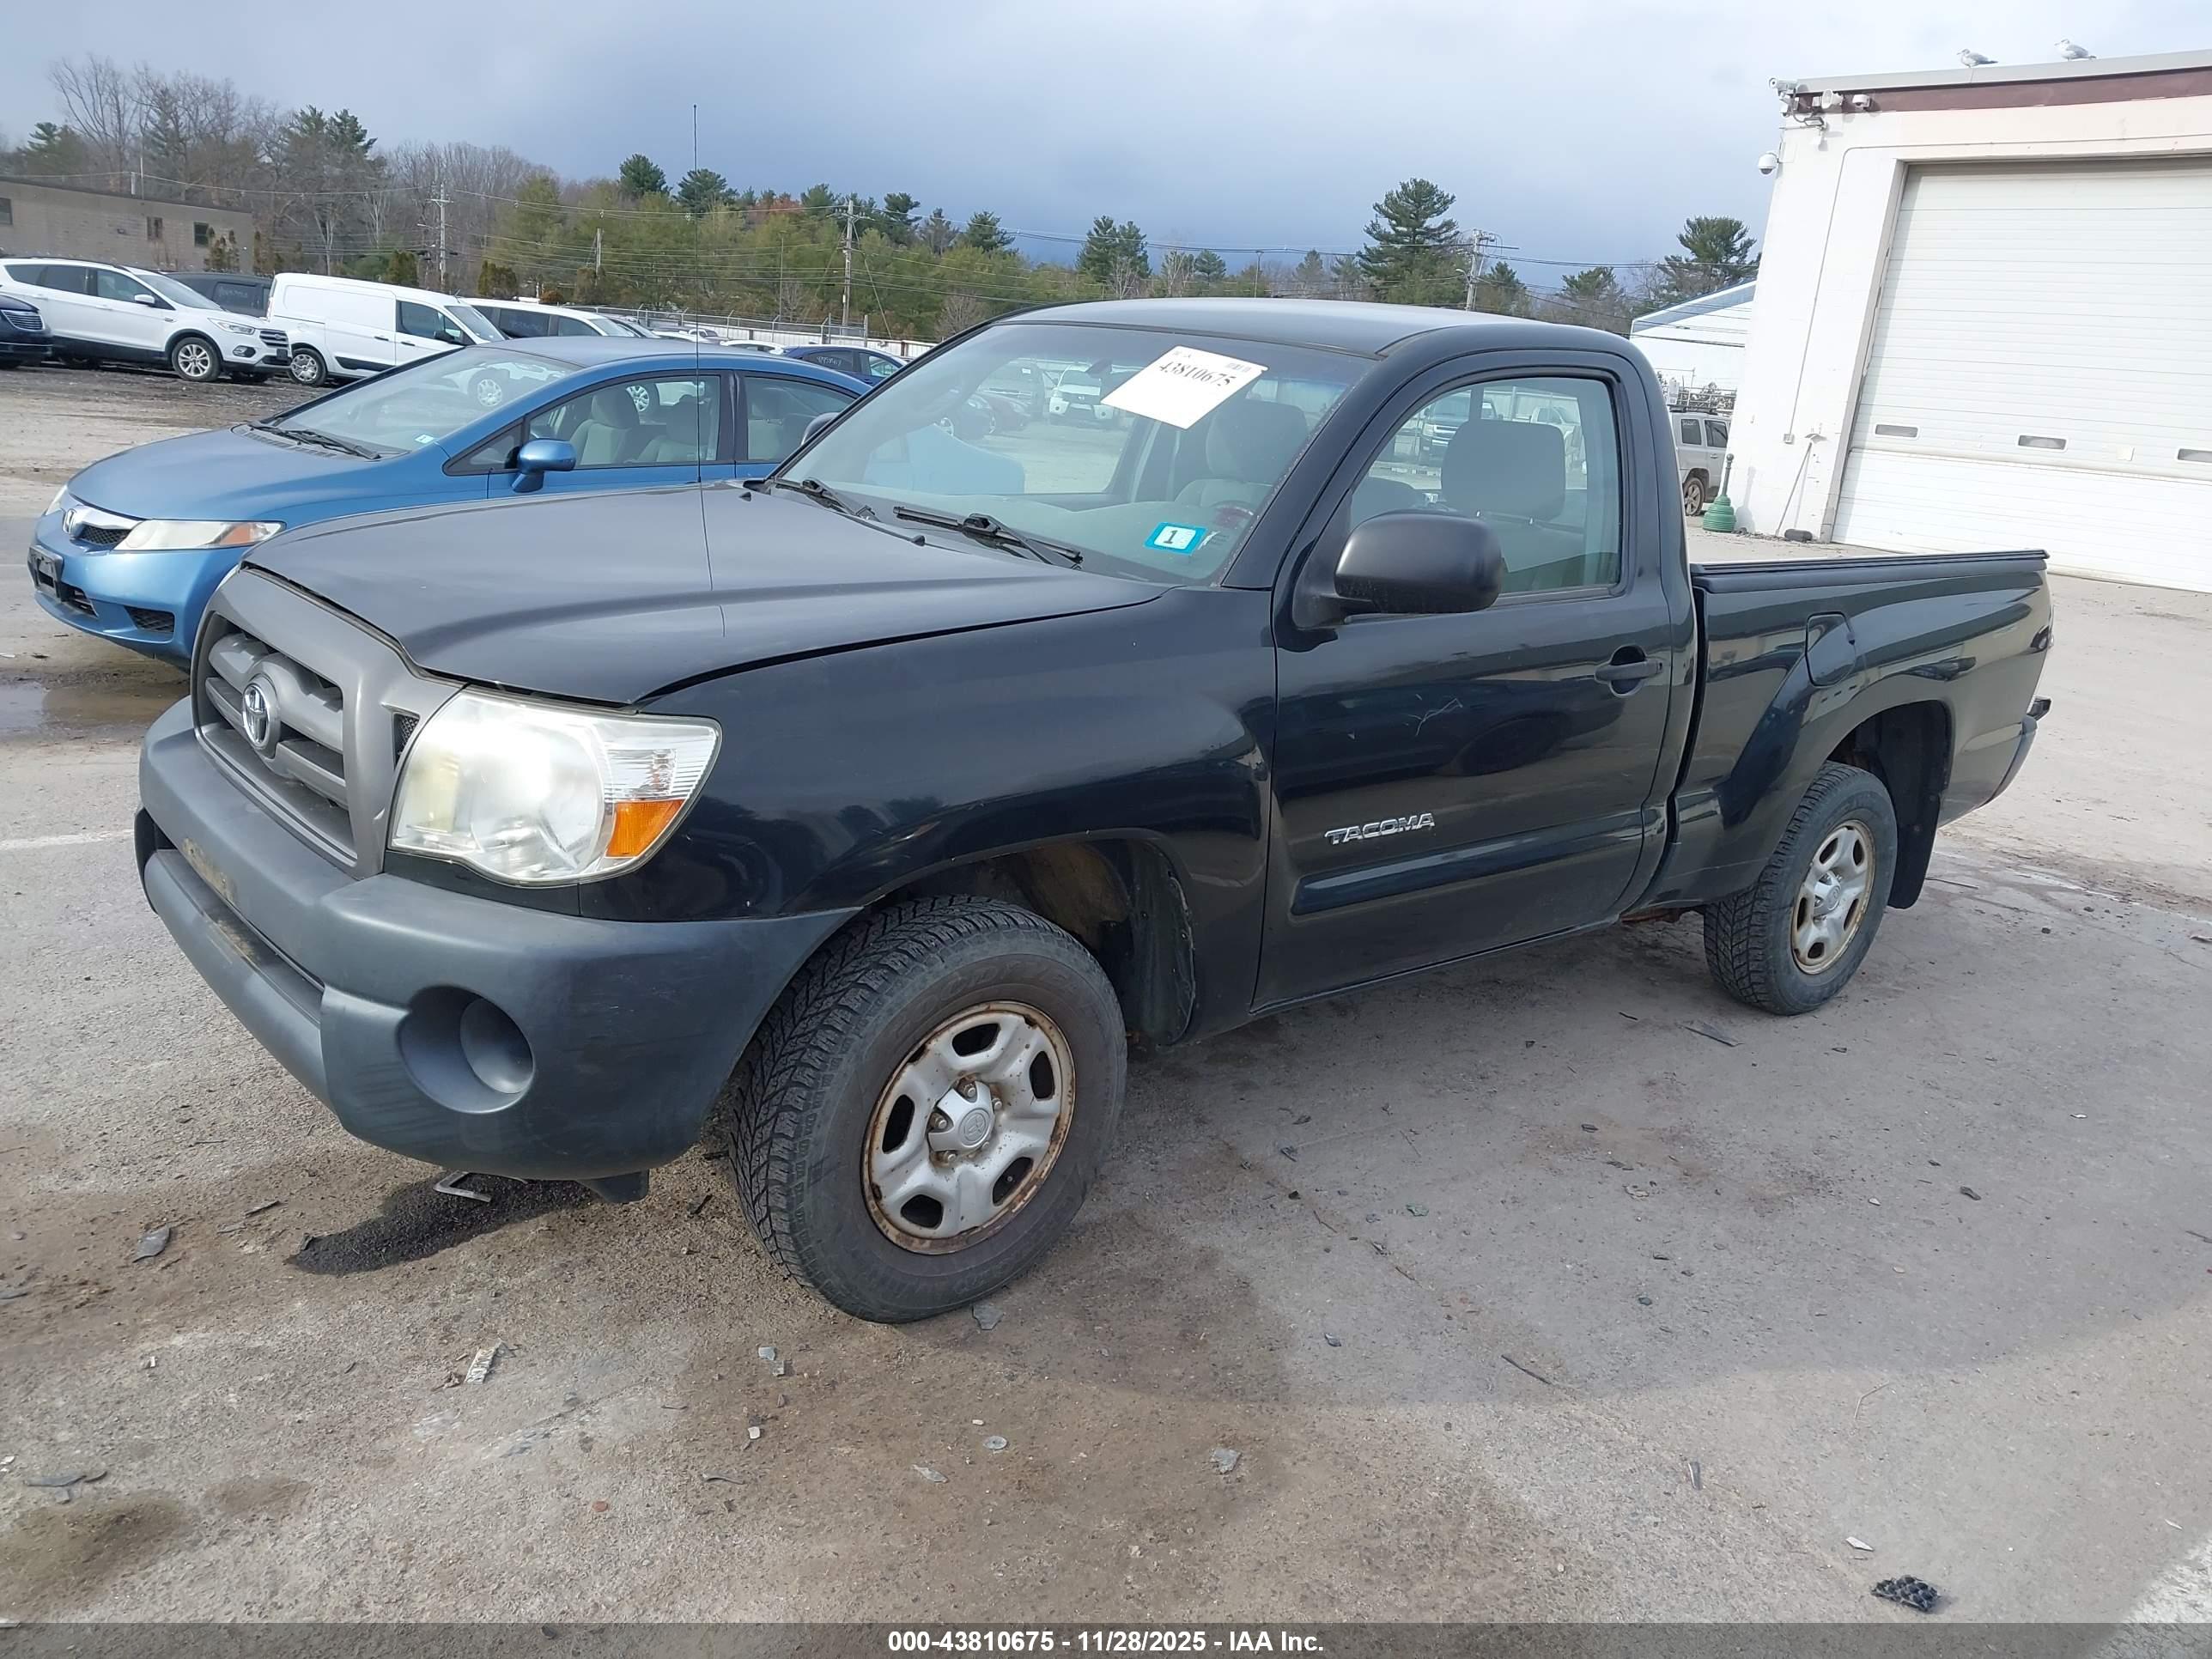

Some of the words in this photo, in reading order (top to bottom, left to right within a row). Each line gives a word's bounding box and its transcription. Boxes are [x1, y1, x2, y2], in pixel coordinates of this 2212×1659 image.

[1159, 361, 1237, 386] 43810675
[1163, 529, 1178, 544] 1
[1324, 812, 1435, 845] TACOMA
